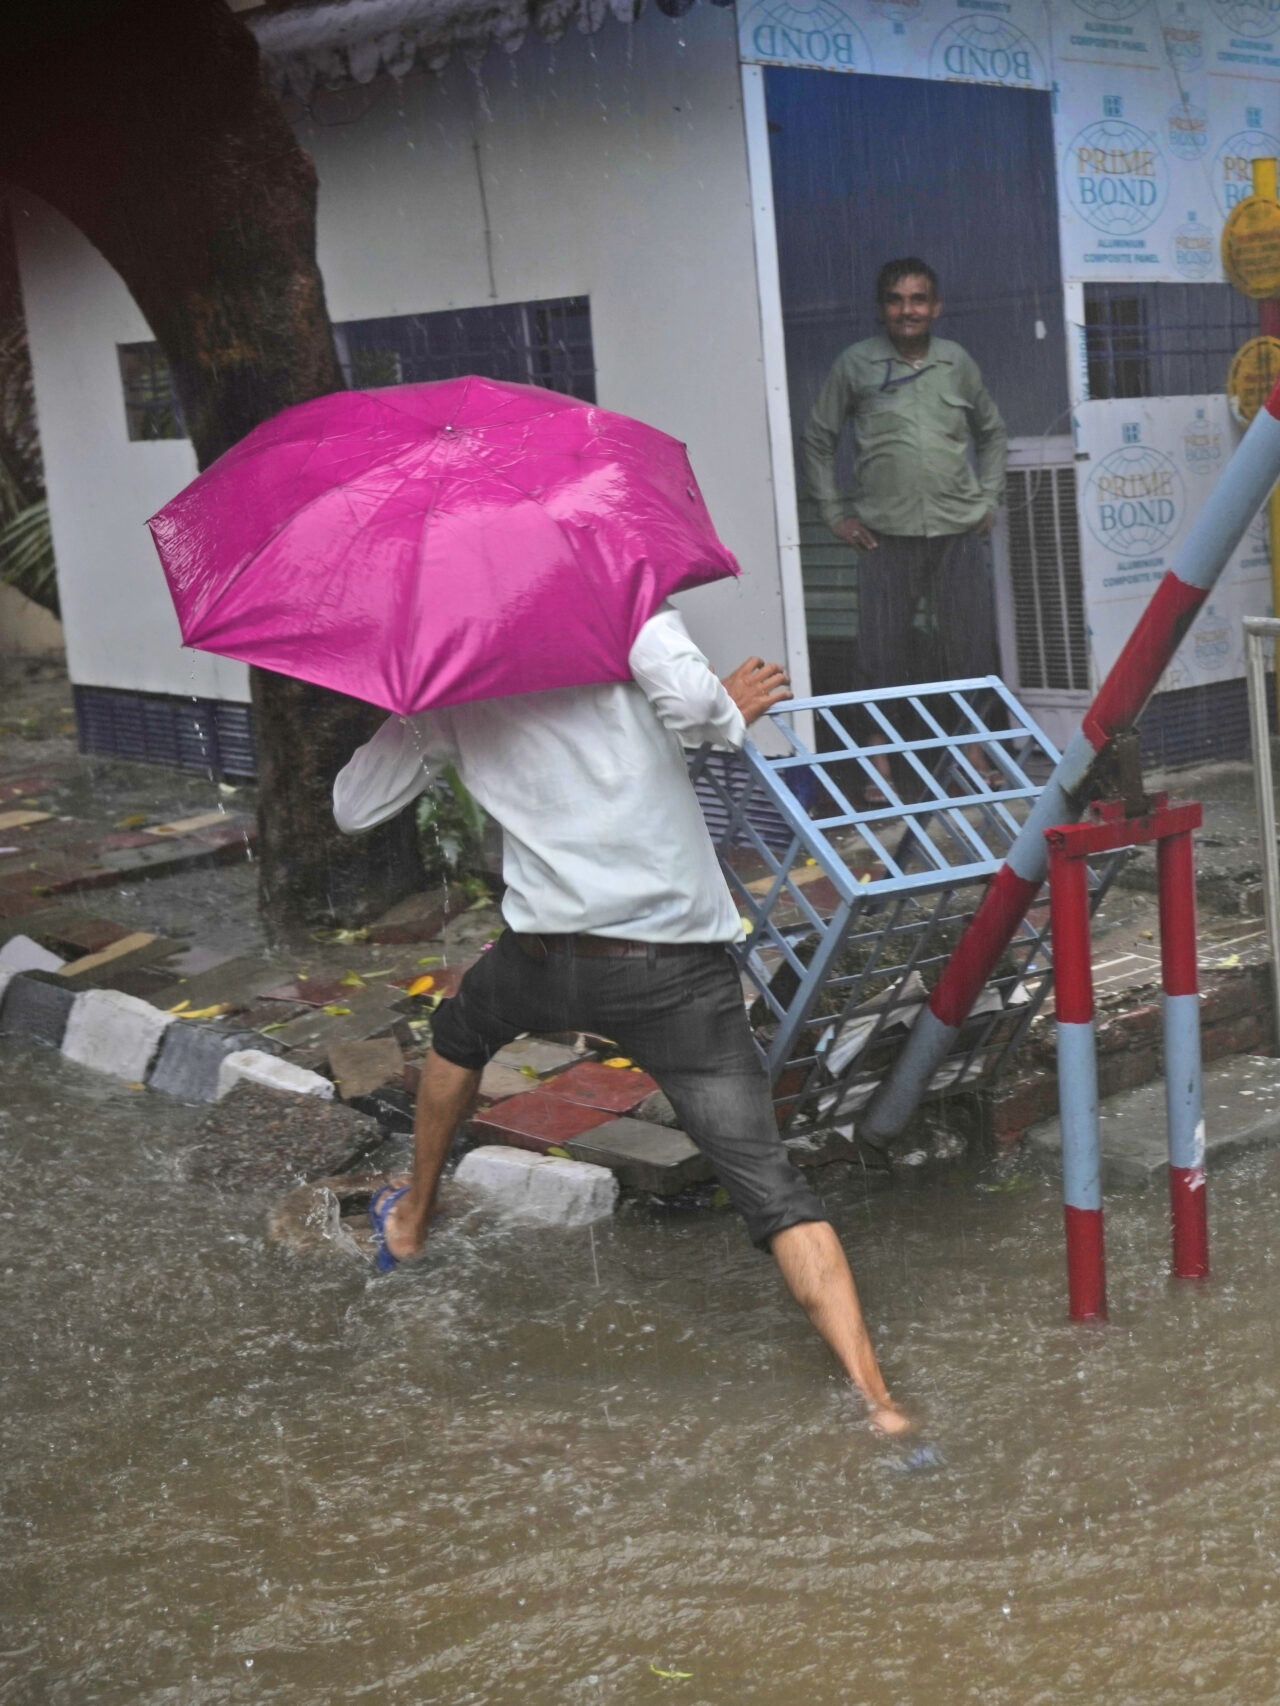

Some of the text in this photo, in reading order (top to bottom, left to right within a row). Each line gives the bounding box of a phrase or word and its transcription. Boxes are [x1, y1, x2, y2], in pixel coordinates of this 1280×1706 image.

[752, 24, 855, 65] BOND
[944, 45, 1032, 80] BOND
[1077, 148, 1156, 177] PRIME
[1079, 177, 1158, 207] BOND
[1098, 472, 1174, 502] PRIME
[1098, 499, 1176, 531] BOND
